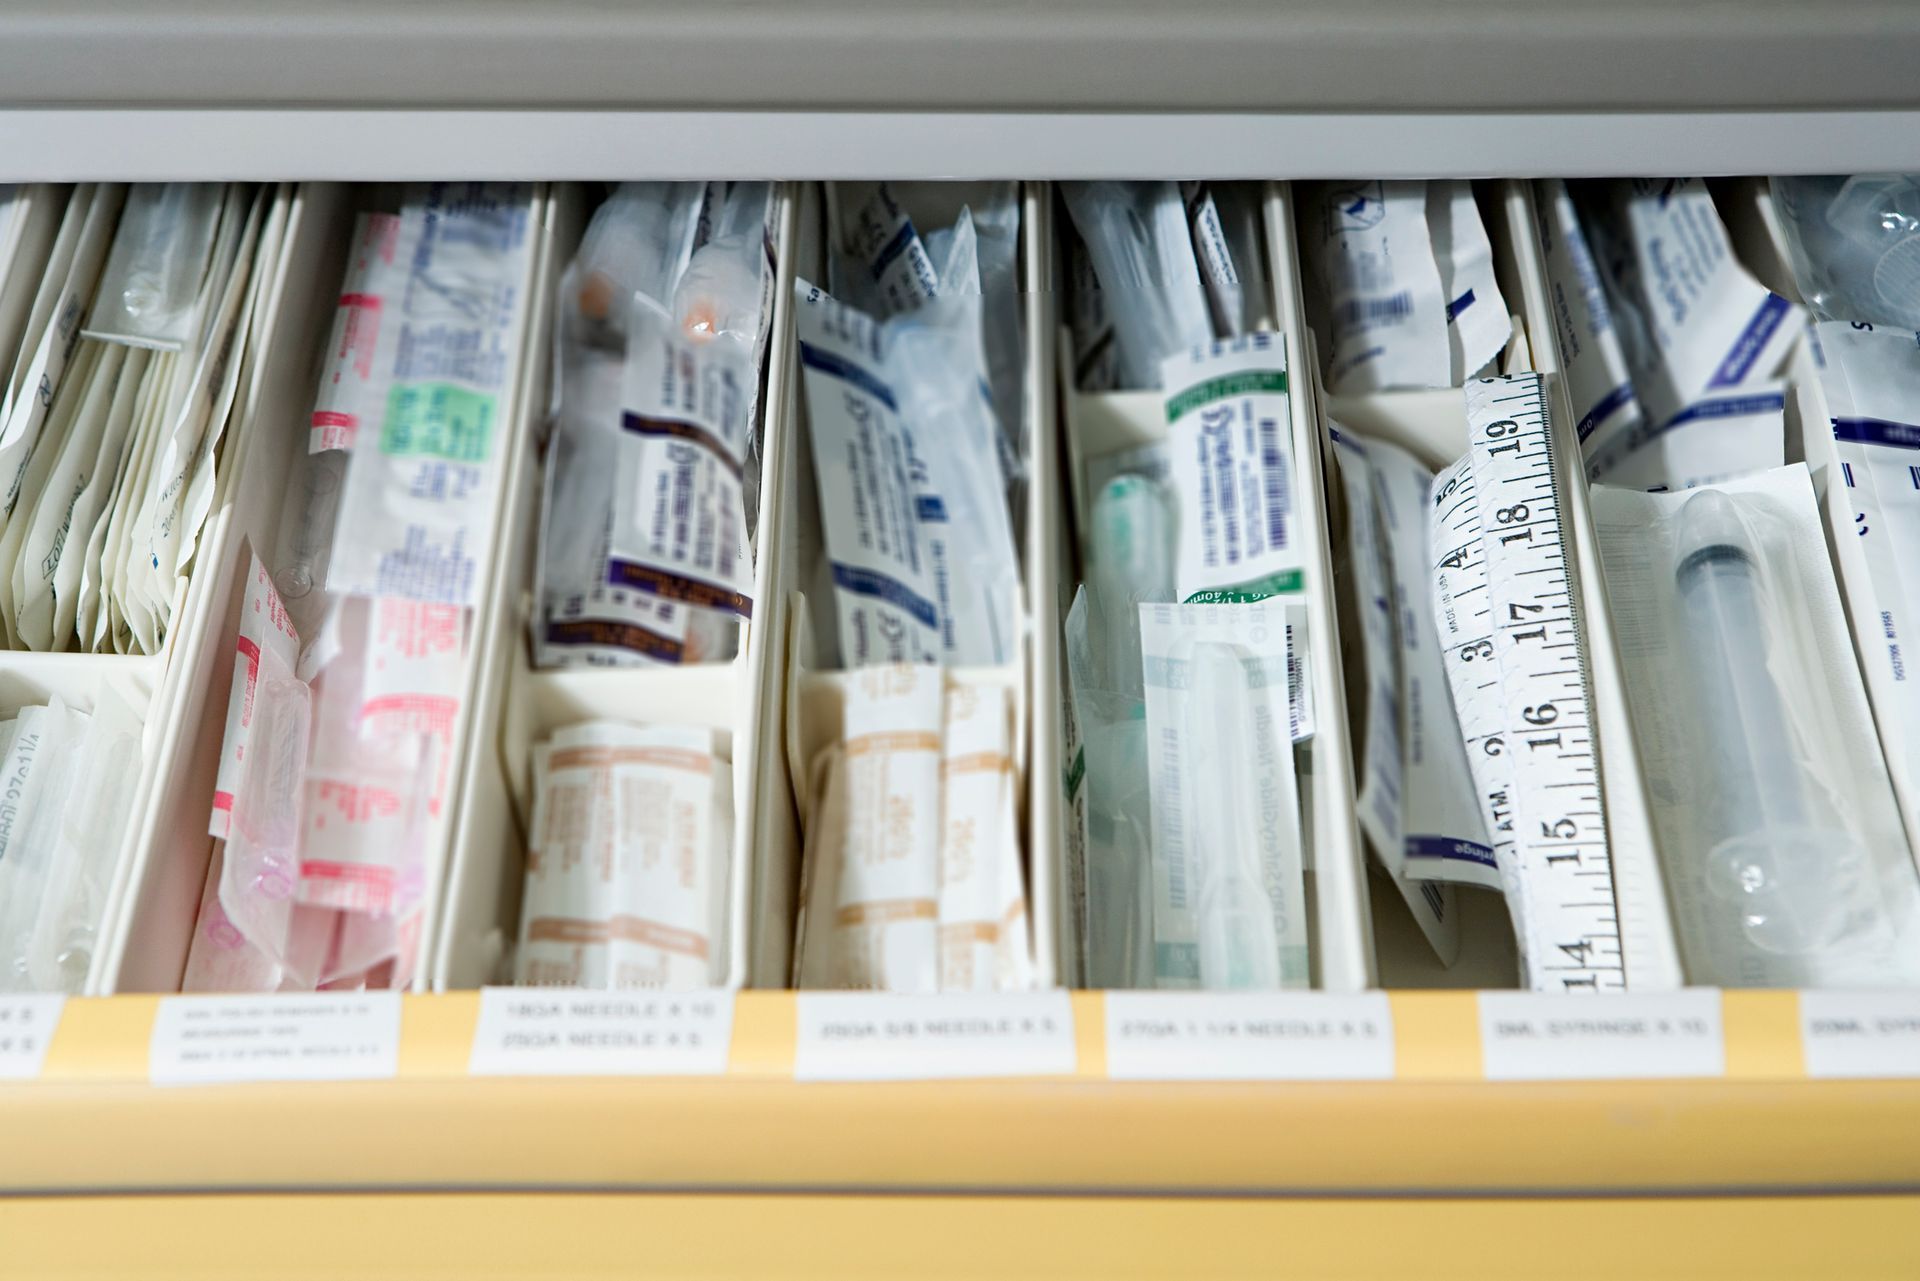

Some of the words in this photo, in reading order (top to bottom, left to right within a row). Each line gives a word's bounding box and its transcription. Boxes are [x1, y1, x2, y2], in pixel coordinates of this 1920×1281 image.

[1485, 420, 1521, 458] 19
[1496, 504, 1534, 547] 18
[1447, 608, 1459, 633] MADE
[1509, 603, 1548, 644] 17
[1523, 703, 1563, 752] 16
[1541, 818, 1581, 868] 15
[1554, 940, 1599, 993] 14
